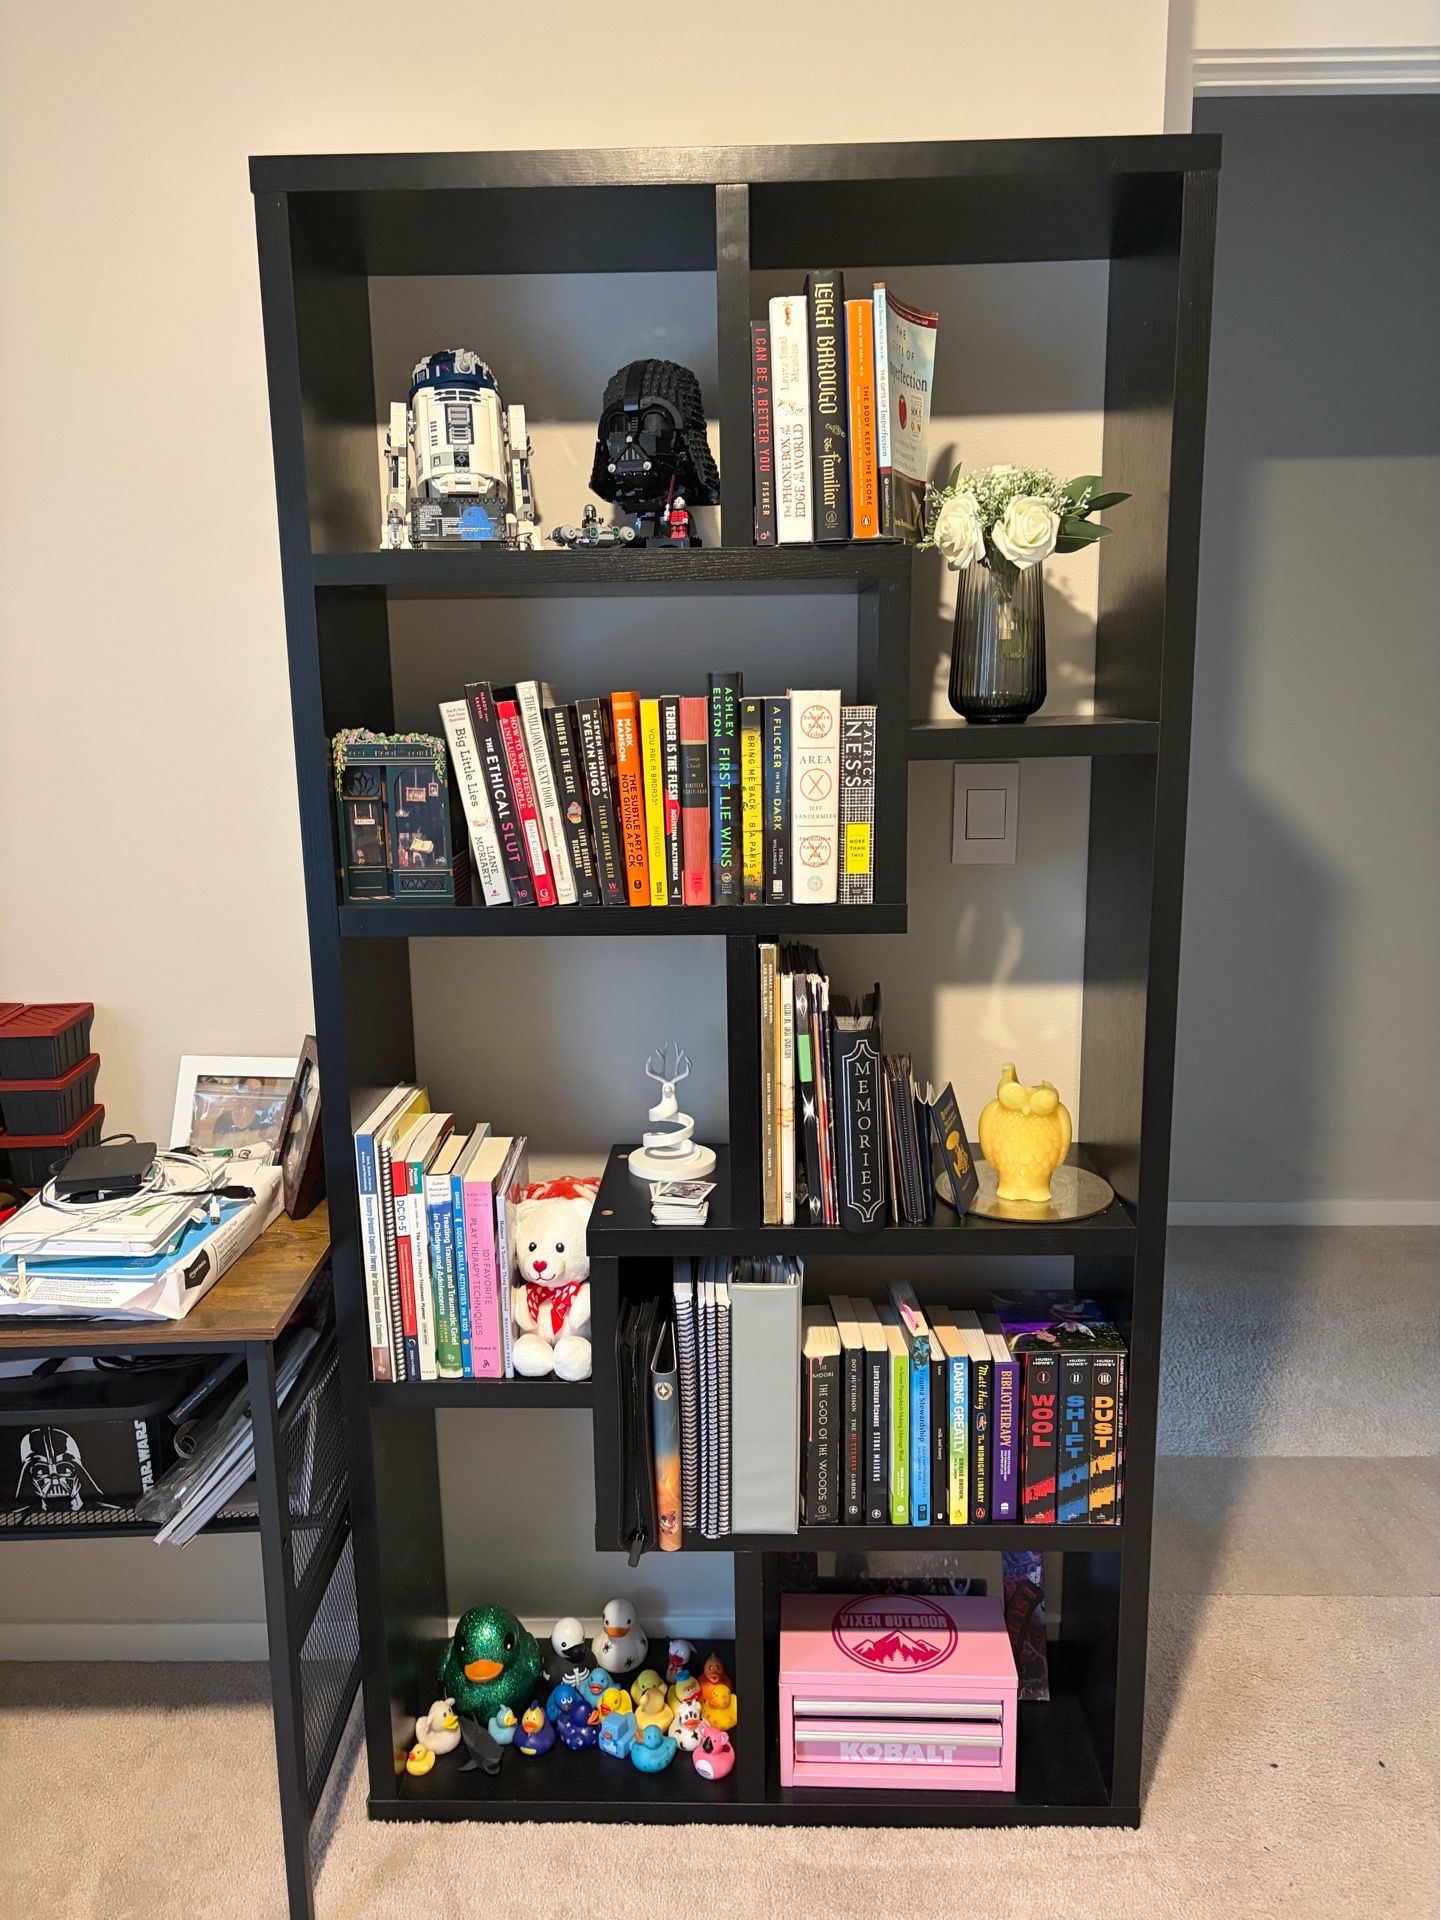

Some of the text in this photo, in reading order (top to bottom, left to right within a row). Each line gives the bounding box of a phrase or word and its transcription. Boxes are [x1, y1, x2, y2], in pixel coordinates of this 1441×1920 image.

[755, 337, 767, 362] CAN
[813, 282, 838, 415] LEIGH BARDUGO
[756, 366, 769, 383] BE
[756, 386, 769, 396] A
[757, 399, 770, 444] BETTER
[863, 404, 871, 428] BODY
[880, 409, 890, 458] Imperfection
[759, 448, 771, 473] YOU
[864, 430, 872, 457] KEEPS
[780, 437, 792, 504] PHONE BOX
[792, 424, 806, 518] EDGE WORLD
[865, 478, 873, 507] SCORE
[762, 480, 772, 517] FISHER
[474, 696, 484, 720] EASTON
[479, 691, 489, 711] HARDY
[712, 687, 722, 738] ELSTON
[724, 687, 734, 737] ASHLEY
[773, 705, 781, 715] A
[455, 727, 468, 748] Big
[523, 695, 555, 809] THE MILLIONAIRE NEXT DOOR
[554, 712, 576, 794] MAIDENS OF THE CAVE
[581, 713, 601, 797] EVELYN HUGO
[616, 718, 627, 762] MANSON
[623, 717, 634, 748] MARK
[648, 727, 656, 746] YOU
[649, 747, 657, 763] ARE
[665, 705, 679, 801] TENDER IS THE FLESH
[773, 718, 782, 769] FLICKER
[845, 720, 862, 788] NESS
[862, 721, 872, 787] PATRICK
[459, 749, 476, 782] Little
[503, 727, 519, 775] INFLUENCE
[514, 777, 527, 810] PEOPLE
[509, 716, 534, 809] HOW TO WIN FRIENDS
[592, 719, 608, 793] SEVEN HUSBANDS
[747, 735, 756, 811] BRING ME BACK
[799, 755, 833, 765] AREA
[466, 782, 481, 808] Lies
[484, 737, 521, 862] THE ETHICAL SLUT
[620, 773, 630, 795] NOT
[623, 796, 634, 831] GIVING
[628, 772, 644, 868] THE SUBTLE ART OF
[718, 747, 733, 868] FIRST LIE WINS
[773, 798, 782, 832] DARK
[526, 821, 544, 874] Dale Carnegie
[571, 839, 583, 869] RICHARDS
[577, 828, 593, 878] LLOYD DEVEREUX
[597, 804, 615, 879] TAYLOR JENKINS REID
[626, 832, 634, 841] A
[670, 808, 680, 881] AGUSTINA BAZTERRICA
[749, 841, 757, 869] PARIS
[474, 836, 493, 887] MORIARTY
[485, 845, 499, 875] LIANE
[853, 1061, 873, 1203] MEMORIES
[433, 1221, 442, 1254] Children
[436, 1254, 444, 1270] and
[442, 1212, 460, 1346] Treating Trauma and Traumatic Grief
[457, 1250, 465, 1271] SKILLS
[469, 1218, 484, 1336] PLAY THERAPY TECHNIQUES
[482, 1249, 493, 1306] 101 FAVORITE
[436, 1270, 447, 1316] Adolescents
[459, 1272, 467, 1306] ACTIVITIES
[818, 1383, 828, 1397] THE
[918, 1369, 926, 1396] Trauma
[818, 1399, 828, 1426] GOD
[873, 1365, 881, 1482] LLOYD DEVEREUX RICHARDS STONE MAIDENS
[916, 1397, 927, 1443] Stewardship
[953, 1362, 965, 1454] DARING GREATLY
[999, 1369, 1013, 1448] BIBLIOTHERAPY
[1030, 1393, 1056, 1448] WOOL
[1065, 1394, 1086, 1460] SHIFT
[1093, 1395, 1114, 1449] DUST
[818, 1427, 828, 1441] OF
[818, 1443, 828, 1457] THE
[974, 1364, 989, 1503] Matt Haig MIDNIGHT LIBRARY
[133, 1419, 154, 1495] TAR WARS
[817, 1459, 828, 1502] WOODS
[839, 1613, 949, 1629] VIXEN OUTDOOR
[838, 1741, 957, 1764] KOBALT
